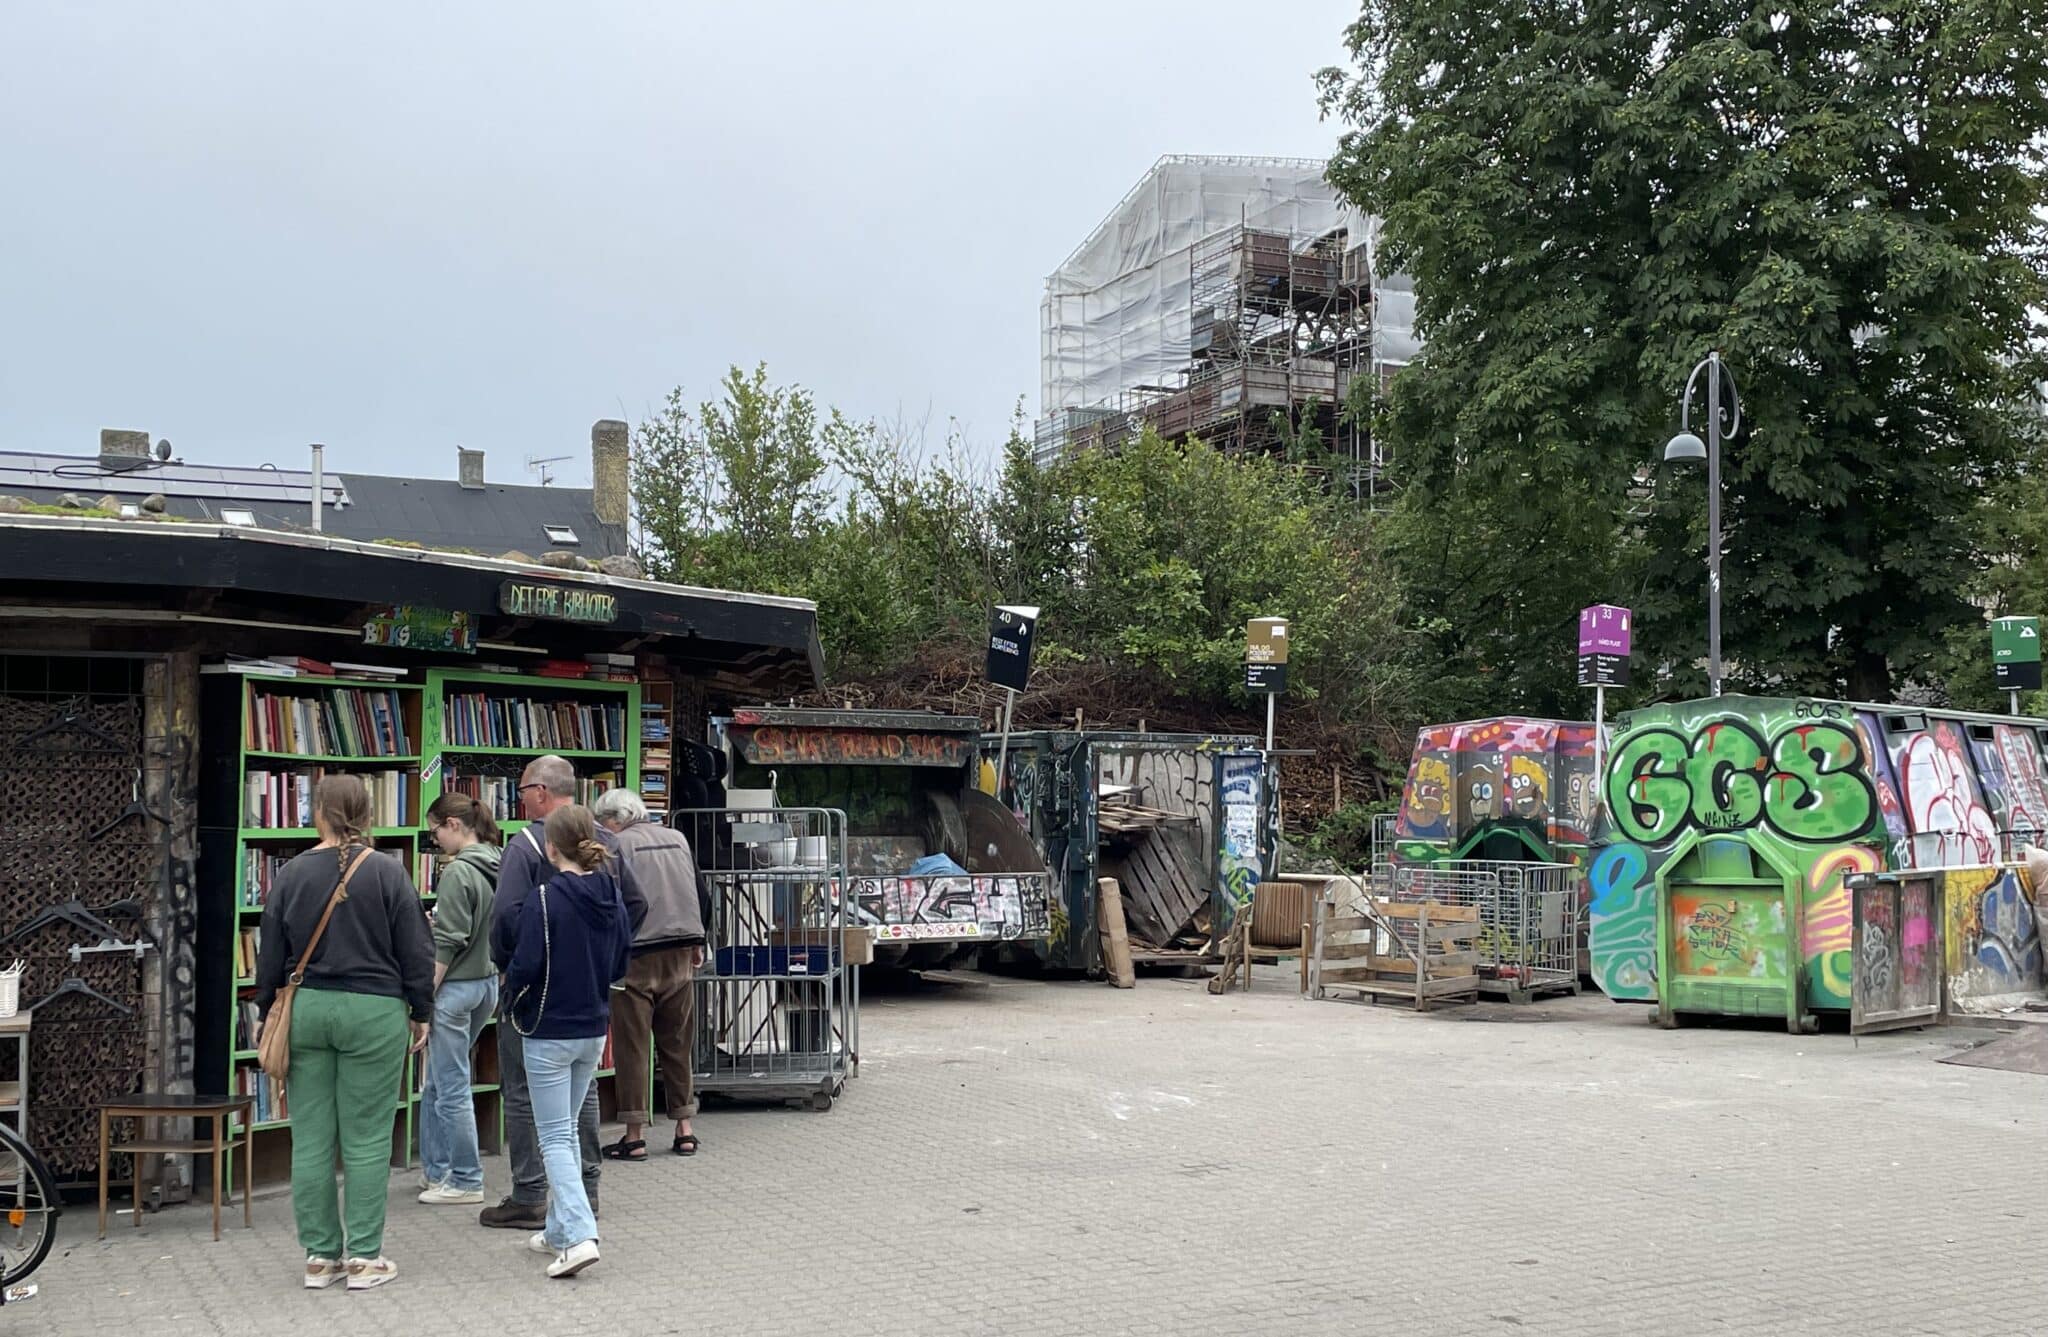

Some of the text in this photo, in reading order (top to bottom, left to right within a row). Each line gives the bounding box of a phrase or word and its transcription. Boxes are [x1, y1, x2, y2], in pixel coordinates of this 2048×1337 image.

[511, 584, 615, 623] DET FRIE BIBLIOTEK
[999, 612, 1011, 624] 40
[1602, 608, 1612, 619] 33
[2001, 621, 2011, 631] 11
[362, 622, 410, 647] BOOKS
